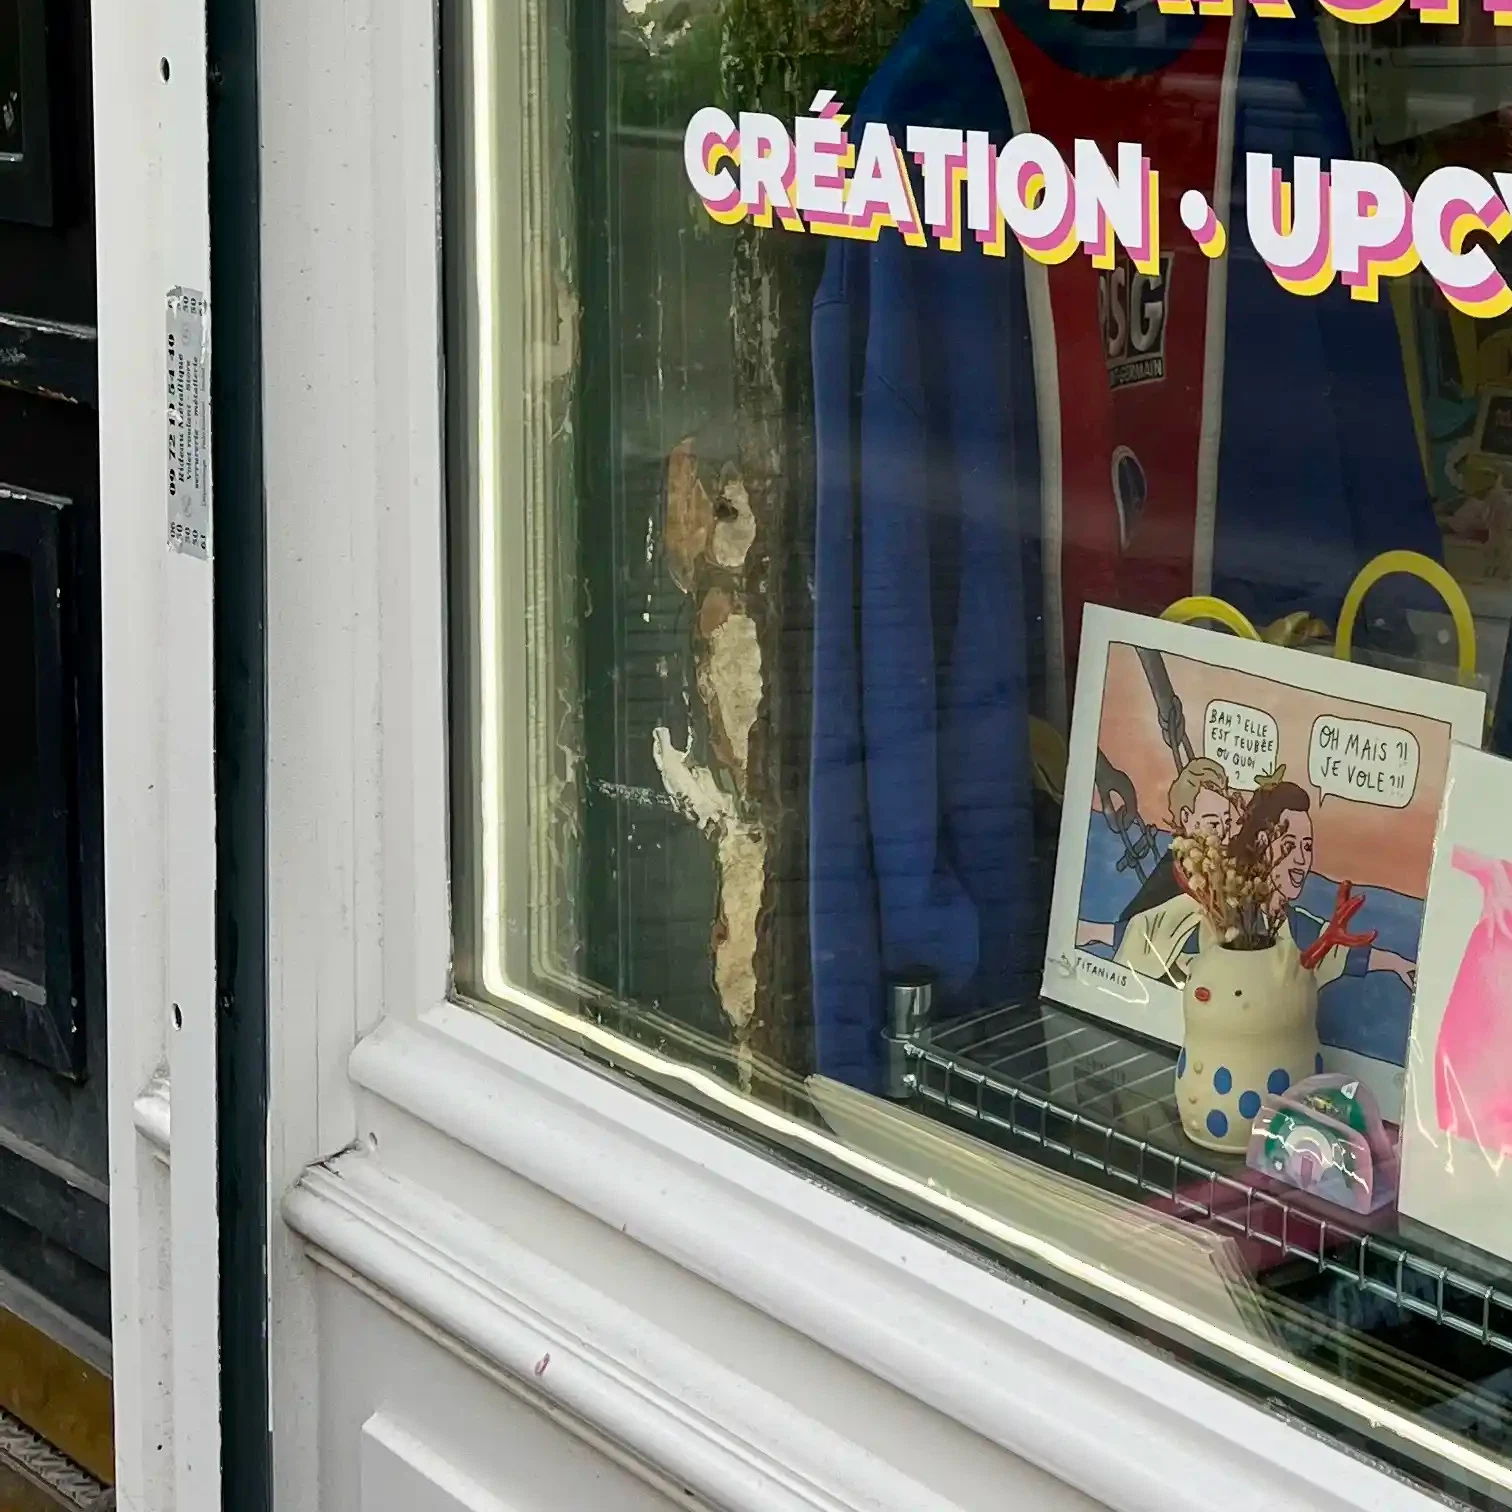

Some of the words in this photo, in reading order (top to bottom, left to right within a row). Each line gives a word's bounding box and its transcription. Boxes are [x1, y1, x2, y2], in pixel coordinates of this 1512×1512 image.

[683, 89, 1160, 276] CRÉATION
[168, 333, 175, 361] 40
[168, 369, 175, 396] 54
[168, 433, 176, 461] 72
[169, 468, 176, 496] 09
[1208, 708, 1233, 728] BAH
[1244, 718, 1268, 738] ELLE
[1211, 727, 1230, 742] EST
[1319, 724, 1340, 751] OH
[1320, 756, 1342, 778] JE
[1347, 764, 1385, 793] VOLE
